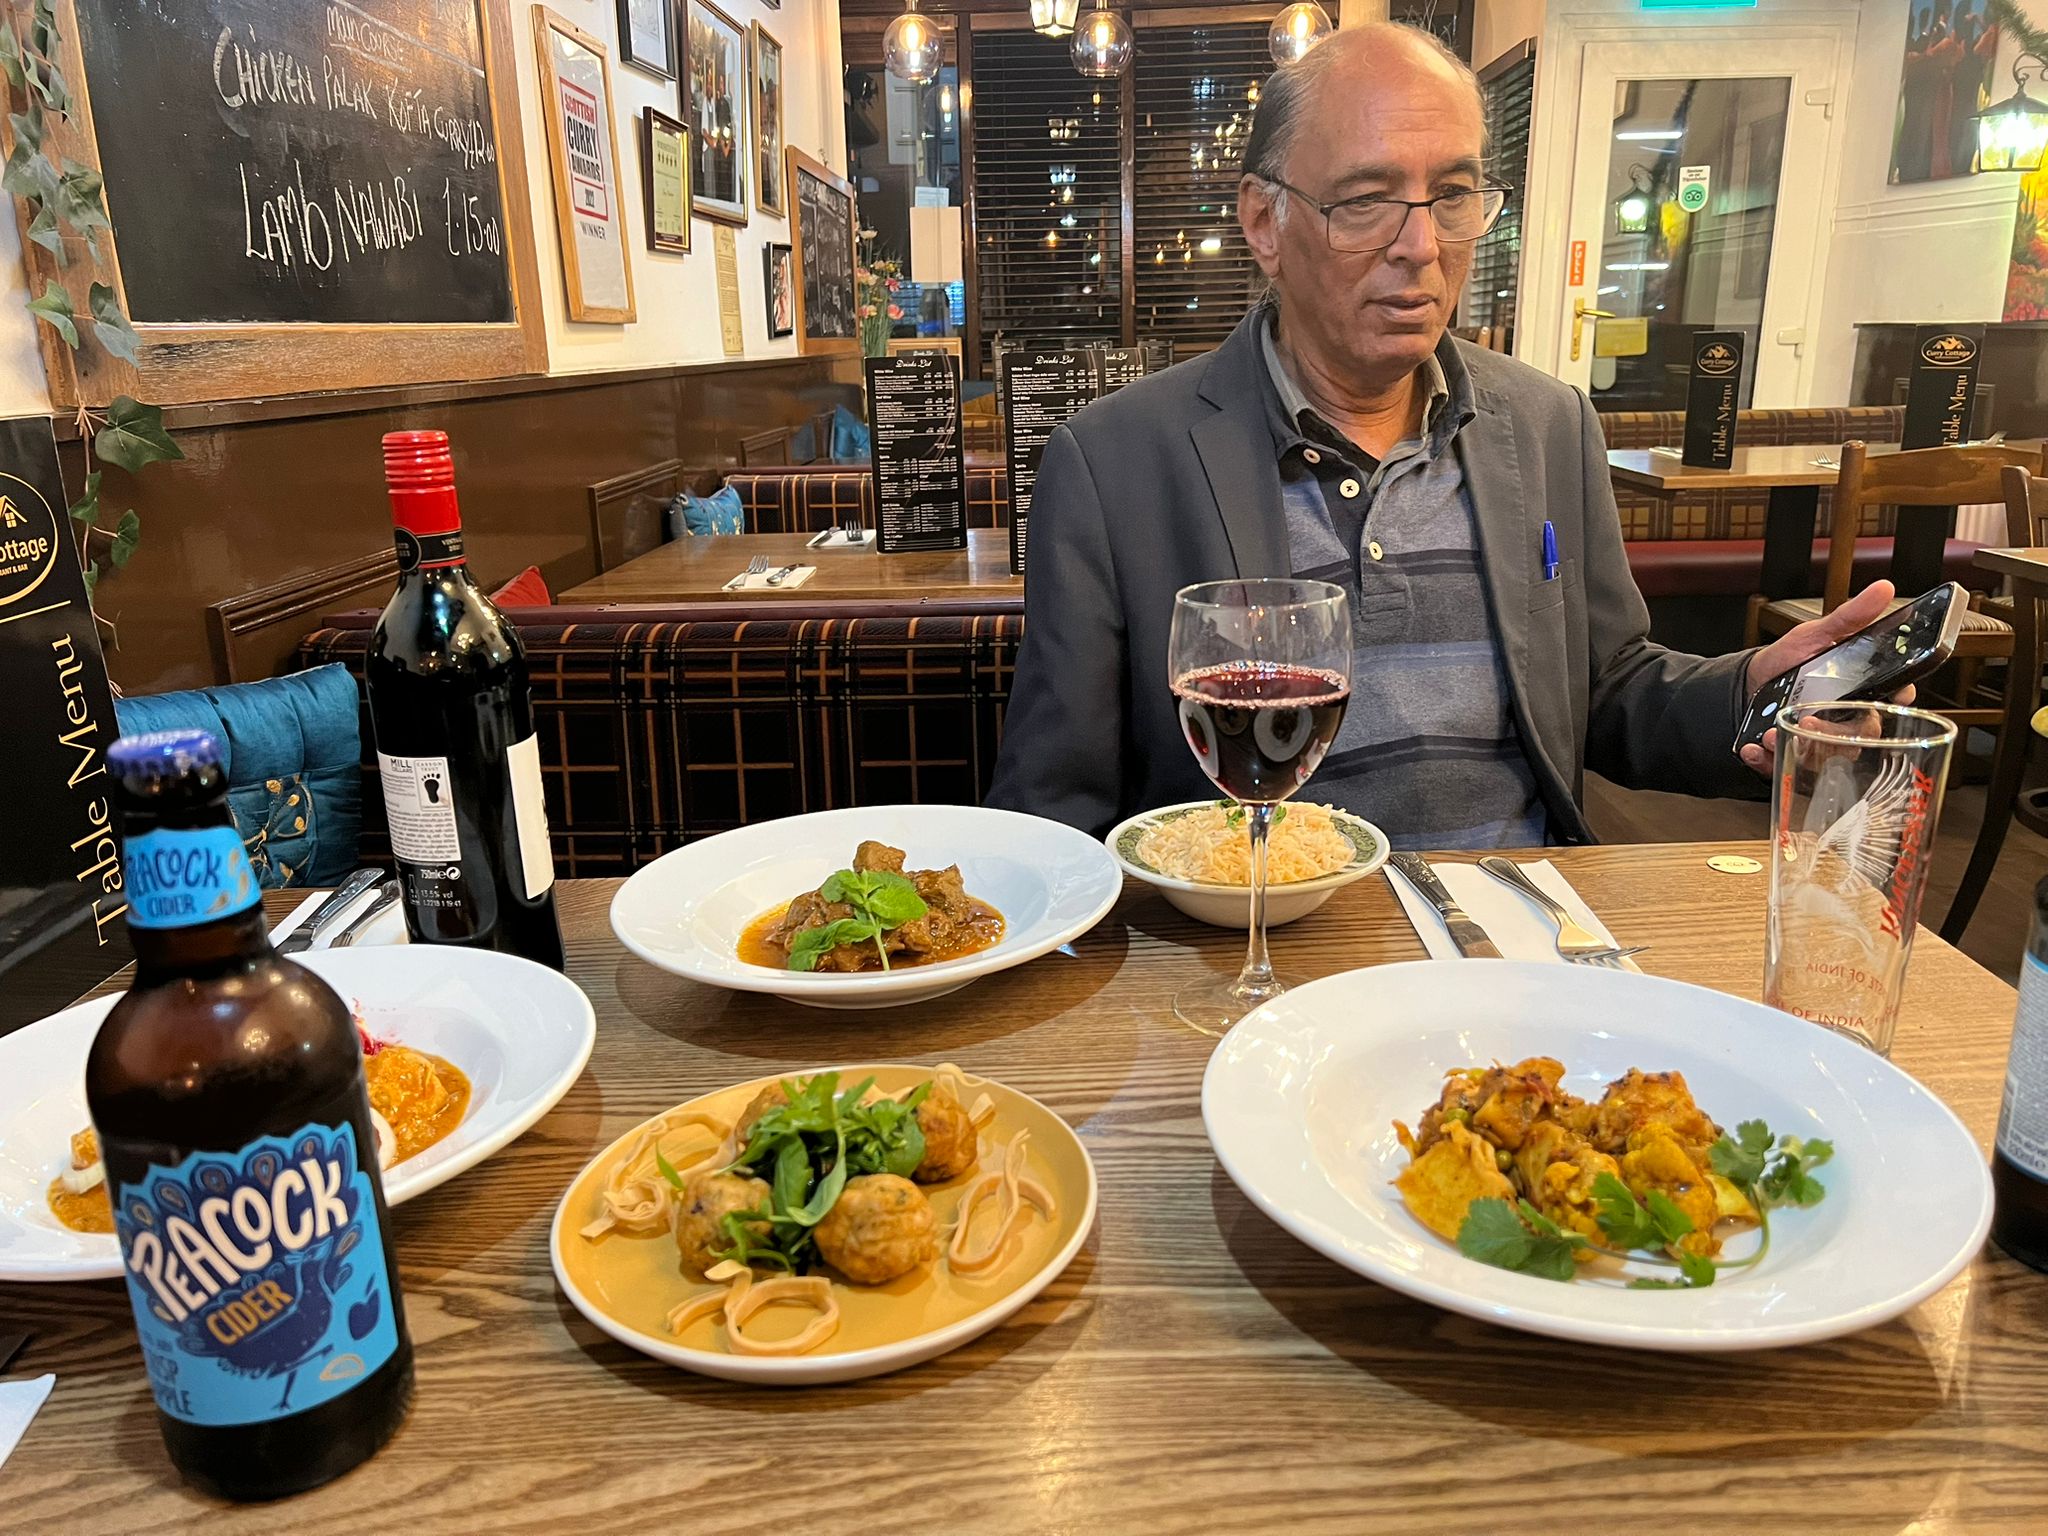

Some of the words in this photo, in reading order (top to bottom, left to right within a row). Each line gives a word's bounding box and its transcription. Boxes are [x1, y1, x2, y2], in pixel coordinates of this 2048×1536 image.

[565, 93, 595, 124] SCOTTISH
[567, 115, 598, 160] CURRY
[571, 153, 601, 183] AWARDS
[580, 221, 606, 241] WINNER
[895, 359, 917, 368] Drinks
[918, 358, 933, 368] List
[1035, 355, 1059, 365] Drinks
[1059, 354, 1075, 365] List
[1926, 350, 1944, 358] Curry
[1944, 349, 1971, 357] Cottage
[1717, 384, 1733, 421] Menu
[1948, 374, 1968, 411] Menu
[1712, 425, 1727, 461] Table
[0, 536, 48, 563] ottage
[51, 632, 108, 790] Menu
[390, 758, 412, 769] MILL
[70, 796, 129, 947] Table
[1818, 1014, 1865, 1027] INDIA
[126, 1158, 349, 1322] PEACOCK
[205, 1279, 294, 1346] CIDER
